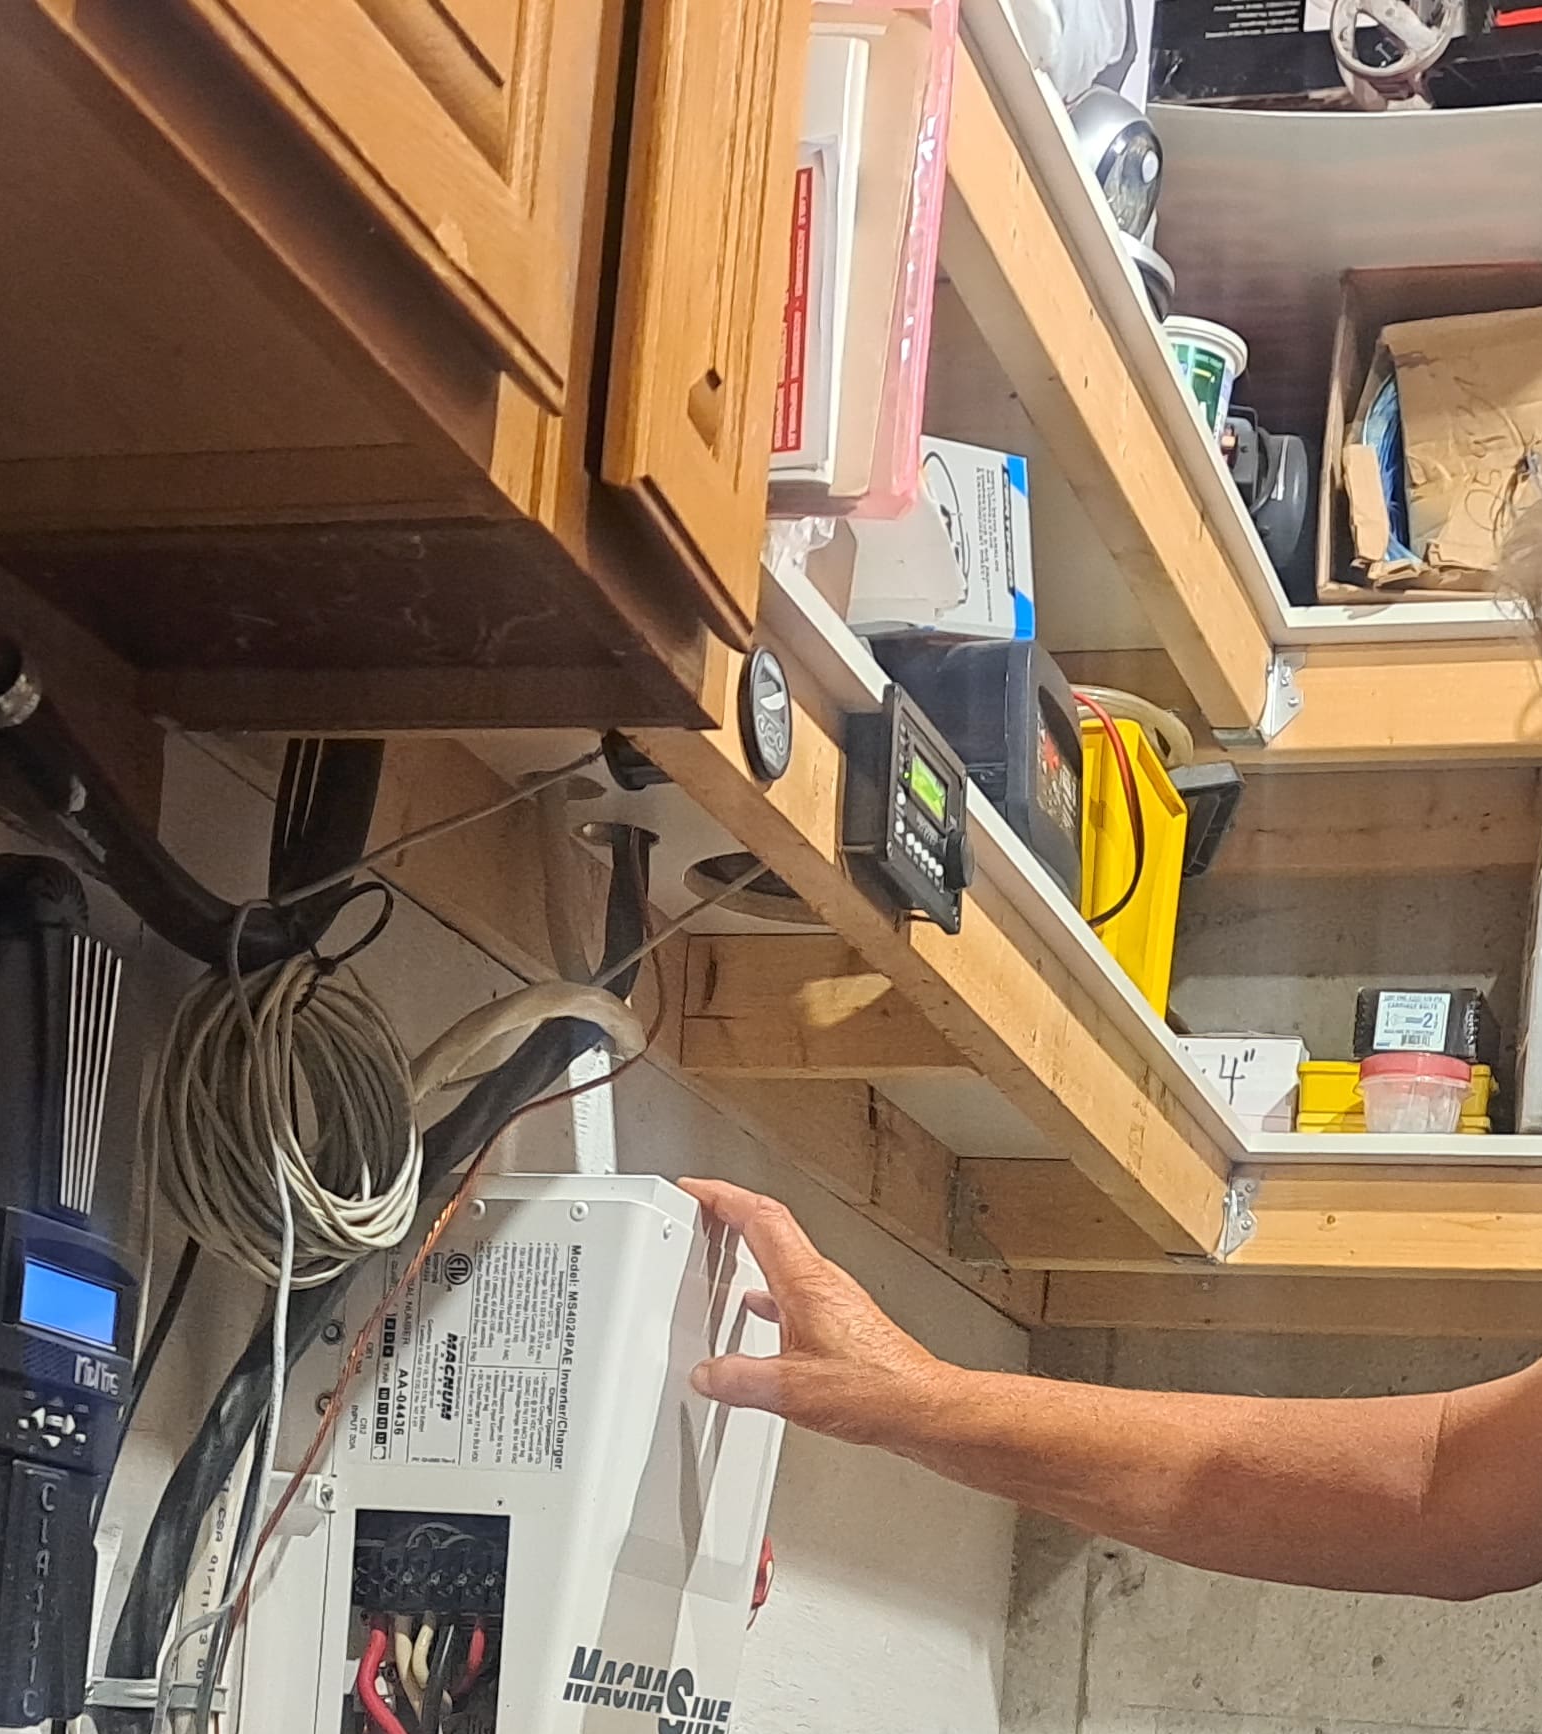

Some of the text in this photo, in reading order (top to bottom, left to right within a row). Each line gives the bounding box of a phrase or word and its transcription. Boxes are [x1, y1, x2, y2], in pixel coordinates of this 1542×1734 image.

[1422, 1012, 1433, 1029] 2
[551, 1244, 581, 1470] Model: MS4024PAE Inverter/Charger
[392, 1368, 408, 1436] AA-04436
